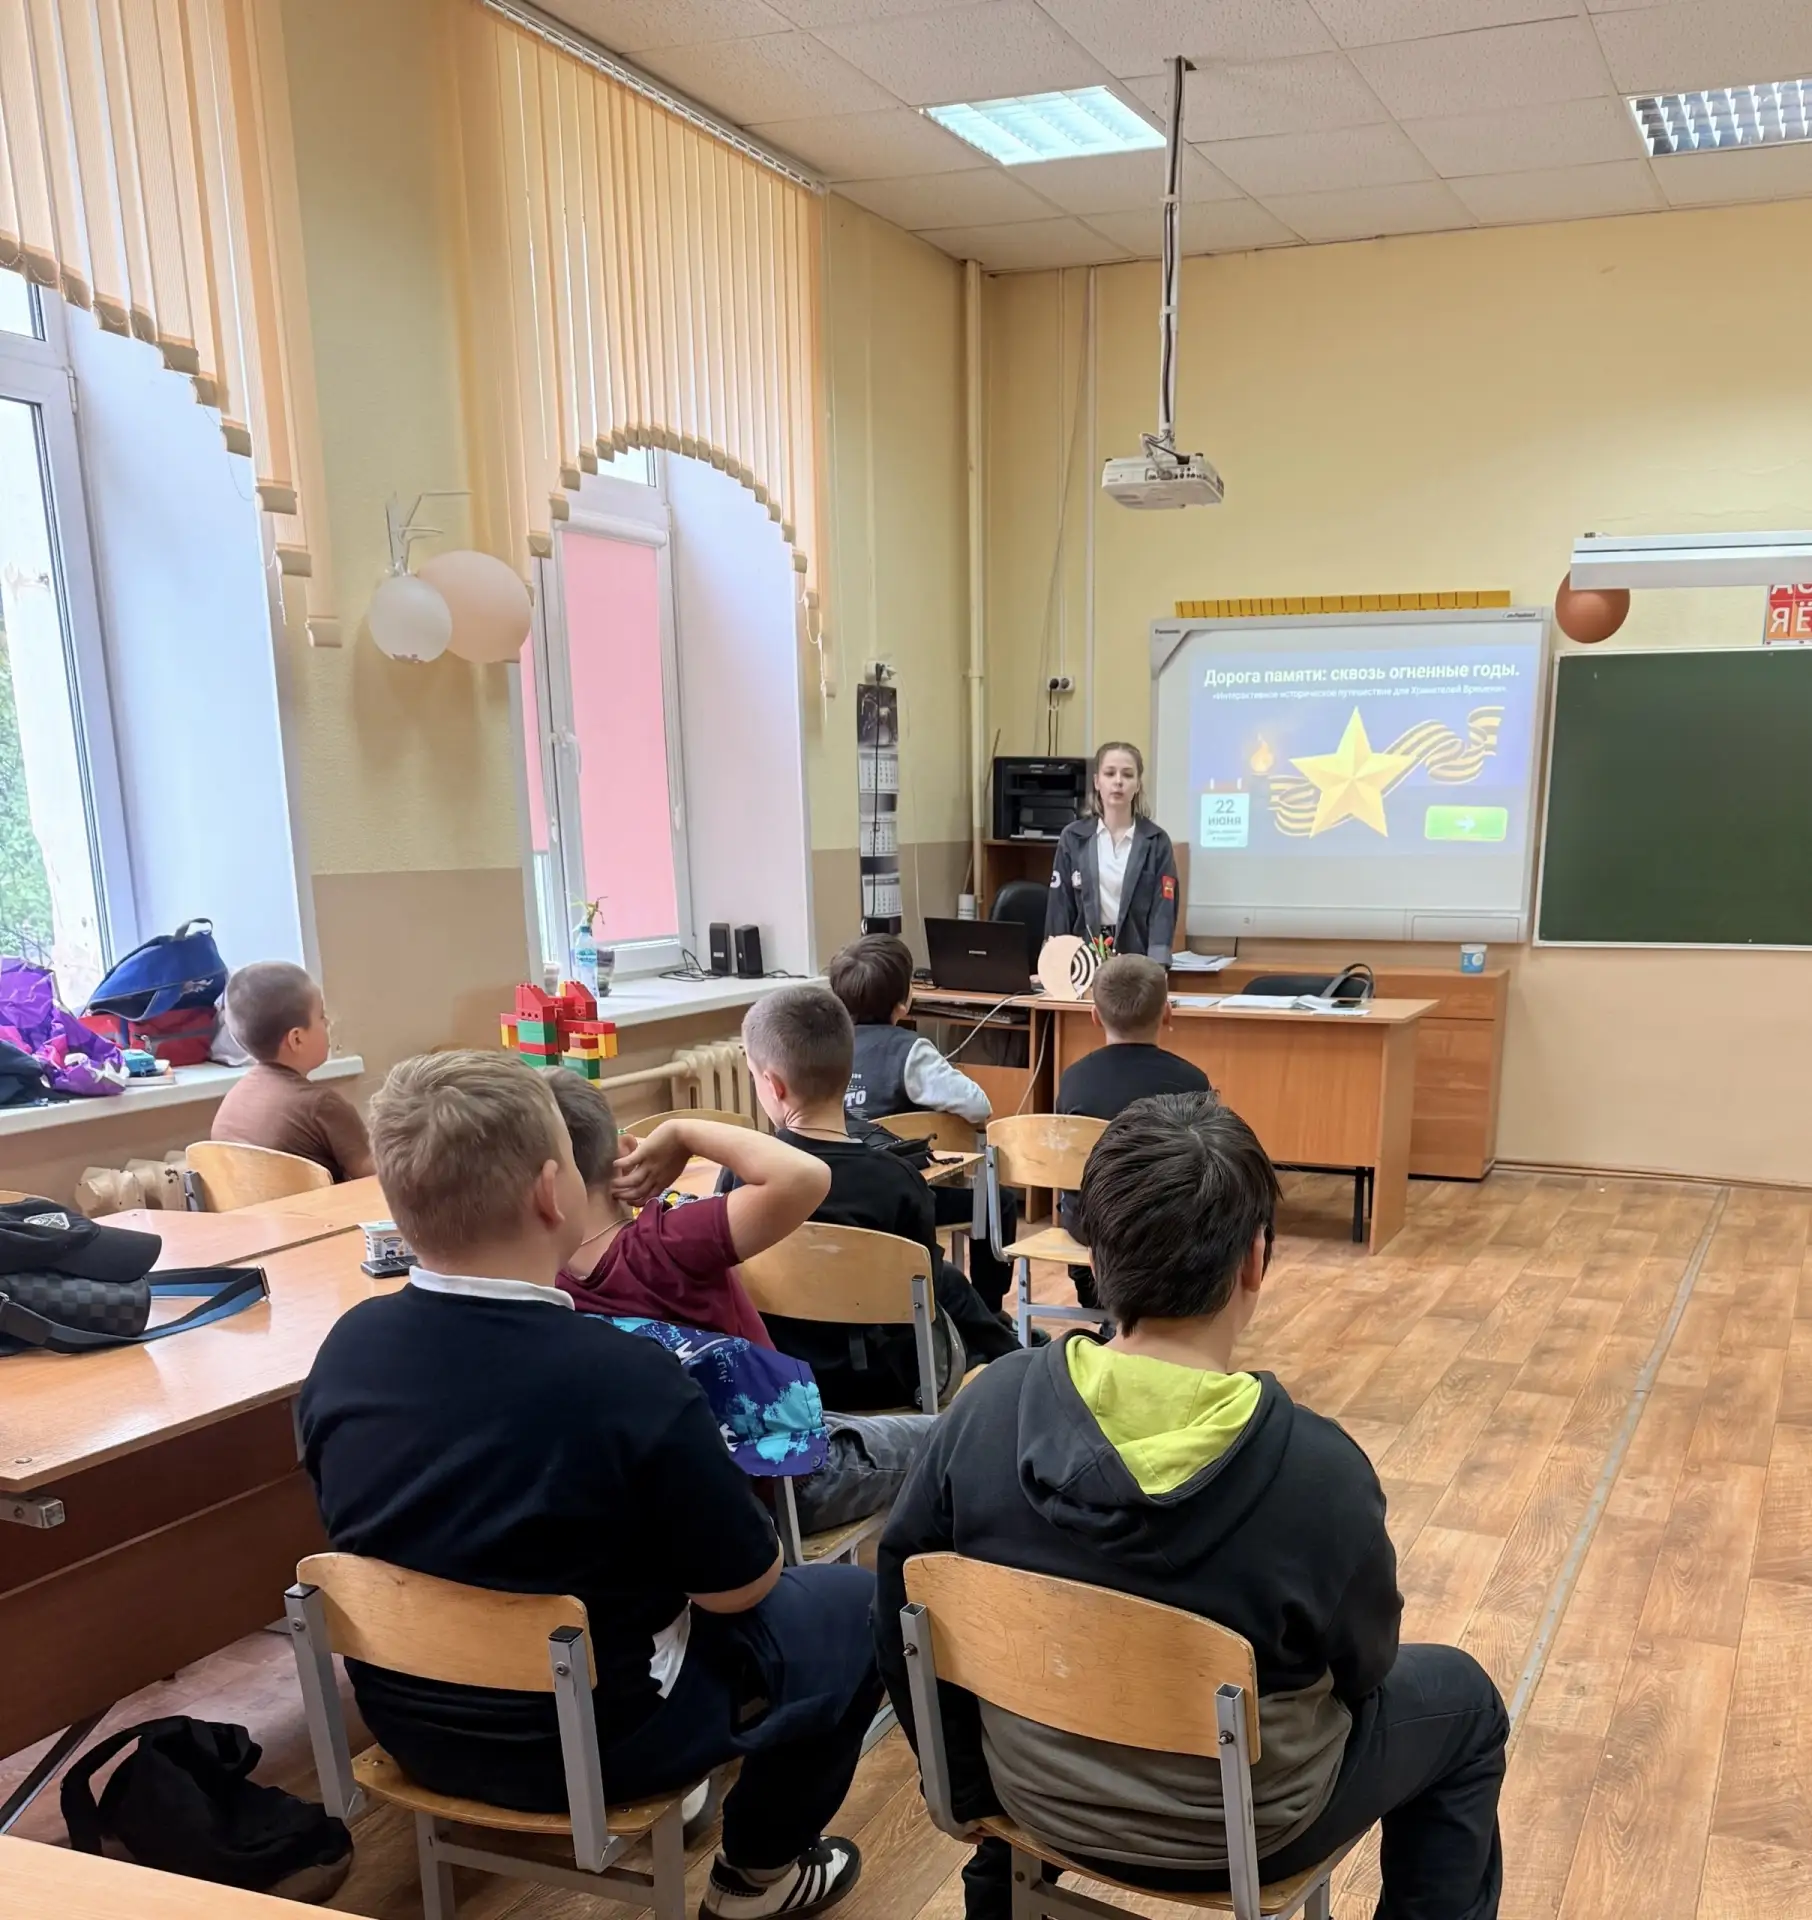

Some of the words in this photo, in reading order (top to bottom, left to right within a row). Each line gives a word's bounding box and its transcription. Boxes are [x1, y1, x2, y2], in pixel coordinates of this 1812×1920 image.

[1203, 668, 1261, 688] Дорога
[1264, 668, 1327, 683] памяти:
[1330, 667, 1385, 681] сквозь
[1389, 664, 1470, 679] огненные
[1472, 663, 1521, 680] годы.
[1214, 798, 1236, 815] 22
